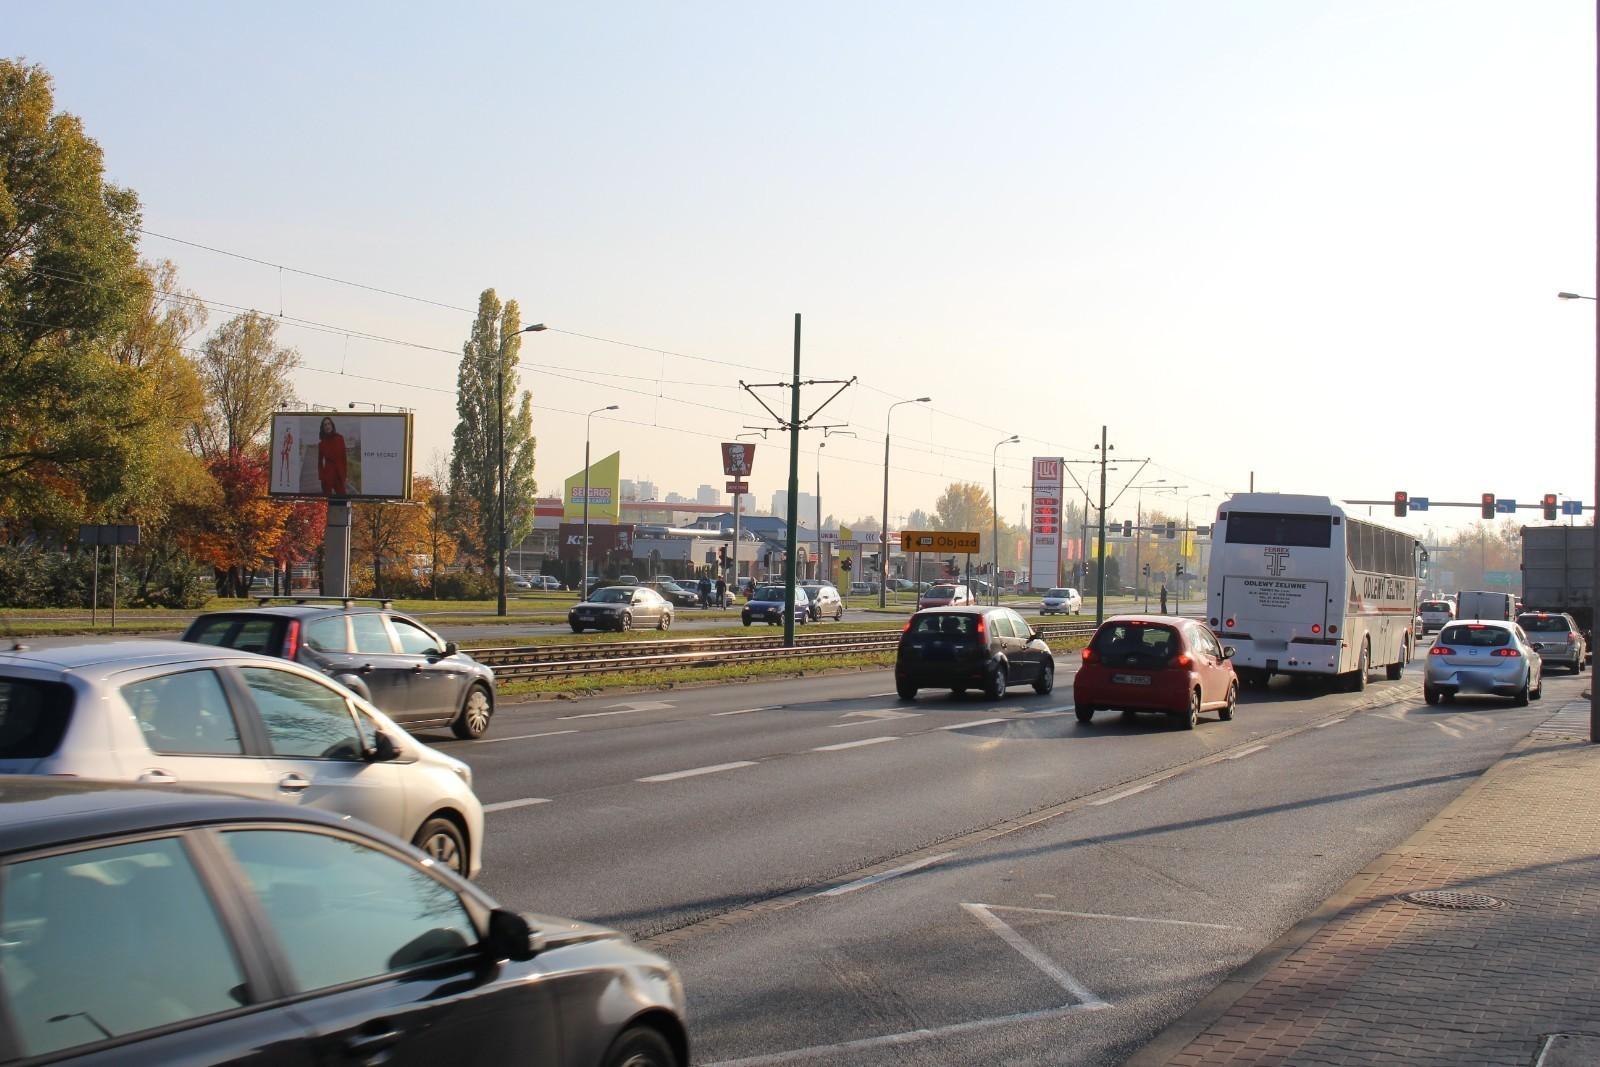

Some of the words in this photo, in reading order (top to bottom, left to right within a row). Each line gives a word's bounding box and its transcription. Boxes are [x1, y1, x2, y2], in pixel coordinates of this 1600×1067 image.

[572, 488, 611, 497] SEGROS
[937, 536, 977, 549] Objazd
[1243, 580, 1274, 588] ODLEWY
